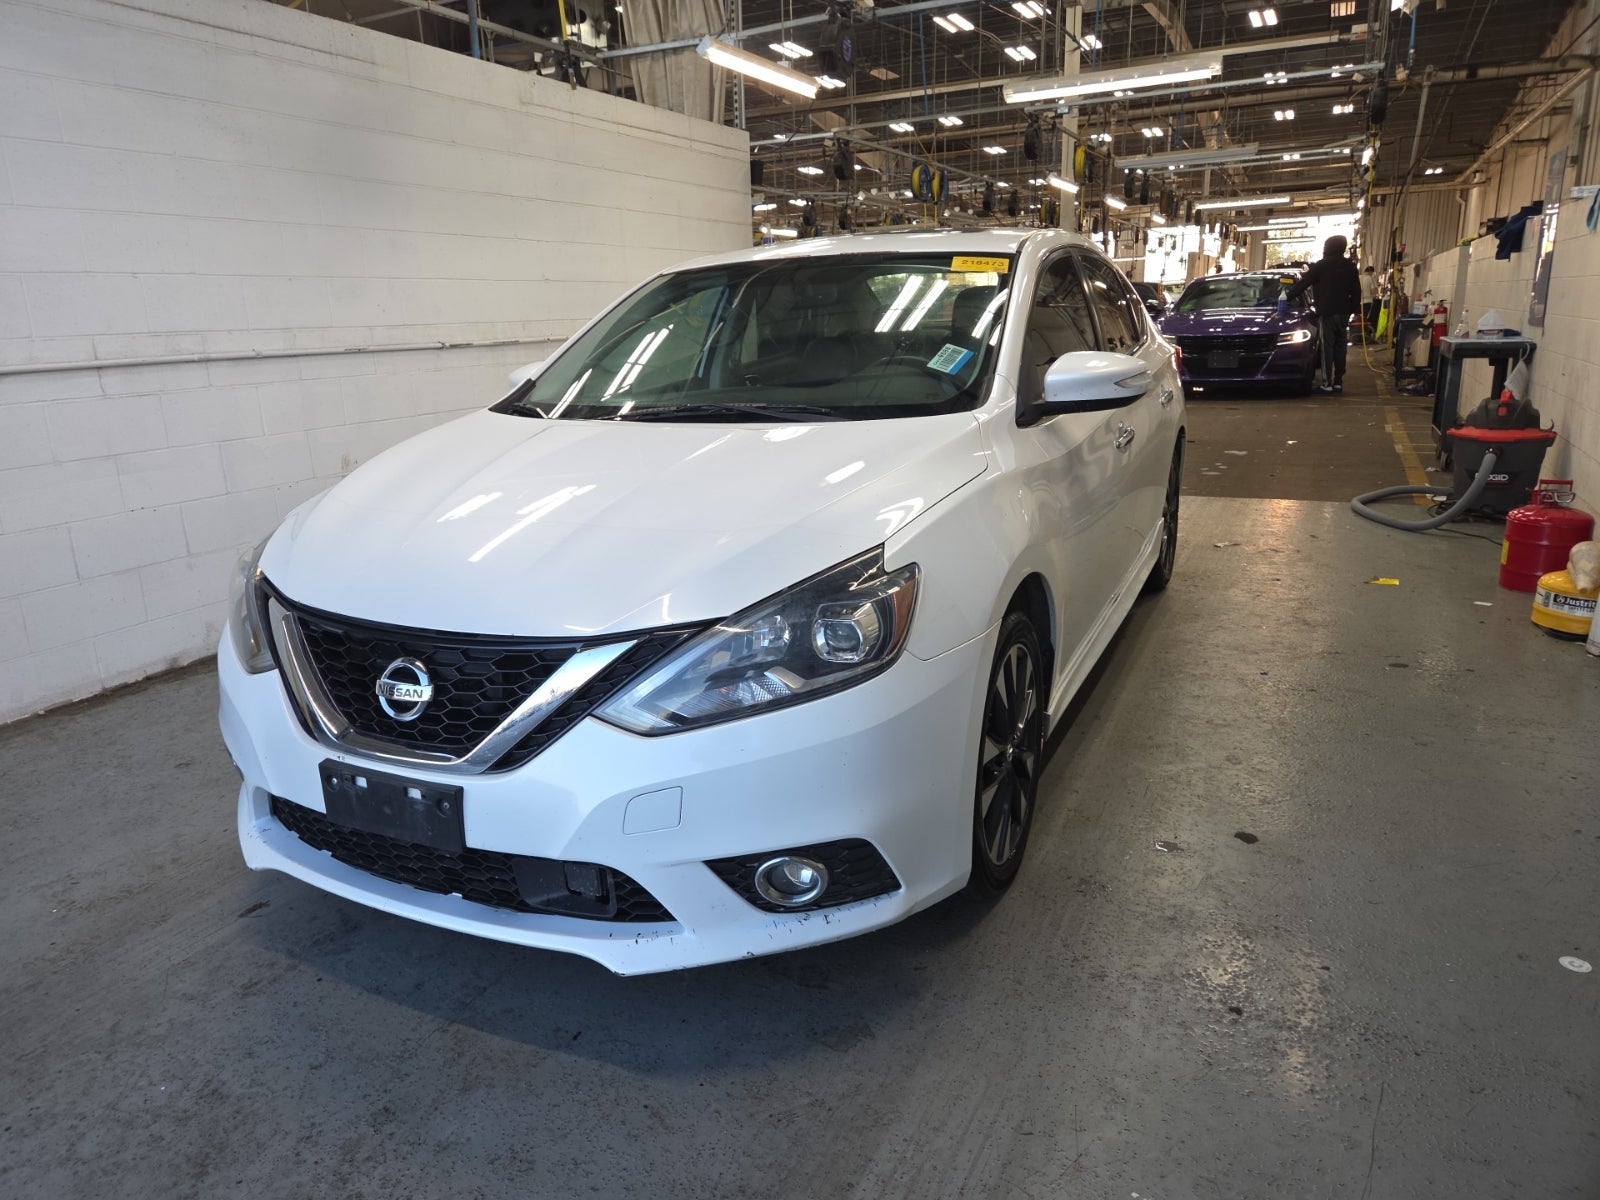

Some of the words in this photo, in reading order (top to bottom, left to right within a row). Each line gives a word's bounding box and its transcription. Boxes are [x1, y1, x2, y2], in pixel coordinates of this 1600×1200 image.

[961, 259, 1004, 267] 218473
[1565, 597, 1596, 608] Justrit
[379, 683, 423, 698] NISSAN
